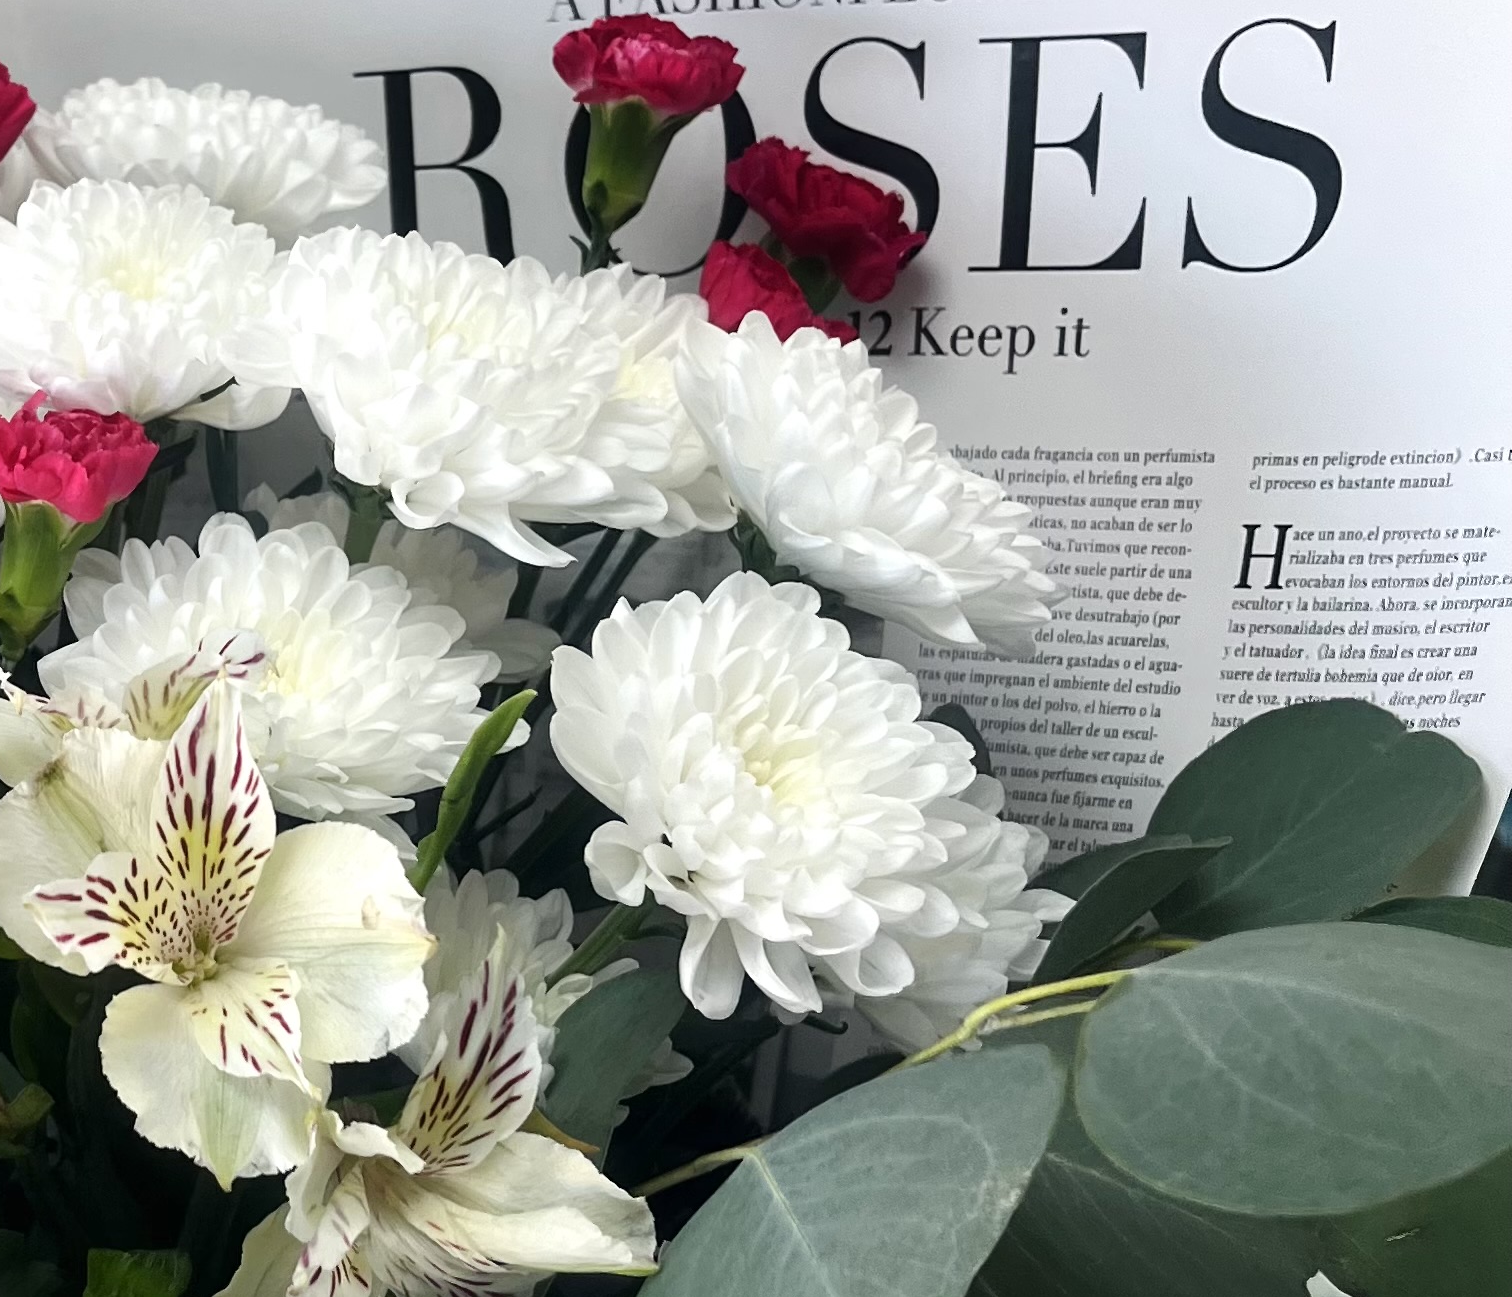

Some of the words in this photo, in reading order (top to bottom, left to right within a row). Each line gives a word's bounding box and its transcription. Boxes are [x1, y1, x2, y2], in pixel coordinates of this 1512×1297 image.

[353, 17, 1343, 273] ROSES
[908, 307, 1036, 374] Keep
[1053, 307, 1090, 357] it
[1001, 446, 1030, 460] cada
[1033, 446, 1093, 463] fragancia
[1097, 451, 1119, 462] con
[1124, 451, 1140, 462] un
[1143, 449, 1215, 466] perfumista
[1252, 452, 1299, 469] primas
[1302, 454, 1318, 466] en
[1073, 470, 1085, 484] el
[1088, 470, 1138, 488] briefing
[1141, 475, 1162, 486] era
[1165, 472, 1193, 489] algo
[1249, 475, 1261, 490] el
[1264, 477, 1316, 493] proceso
[1319, 477, 1333, 490] es
[1338, 474, 1395, 490] bastante
[1017, 493, 1086, 509] propuestas
[1089, 497, 1137, 511] aunque
[1140, 497, 1169, 509] eran
[1173, 498, 1202, 514] muy
[1070, 518, 1087, 530] no
[1090, 516, 1135, 532] acaban
[1138, 517, 1154, 532] de
[1157, 521, 1177, 533] ser
[1180, 517, 1193, 533] lo
[1318, 529, 1335, 541] un
[1382, 528, 1440, 545] proyecto
[1444, 528, 1459, 539] se
[1462, 526, 1501, 539] mate-
[1124, 544, 1148, 558] que
[1151, 544, 1192, 556] recon-
[1289, 550, 1345, 566] rializaba
[1349, 553, 1364, 565] en
[1368, 552, 1393, 565] tres
[1396, 549, 1459, 568] perfumes
[1462, 551, 1487, 565] que
[1074, 561, 1107, 576] suele
[1110, 562, 1146, 581] partir
[1149, 562, 1165, 578] de
[1168, 567, 1192, 579] una
[1285, 573, 1345, 589] evocaban
[1349, 573, 1368, 588] los
[1371, 574, 1429, 589] entornos
[1433, 571, 1453, 587] del
[1106, 589, 1130, 602] que
[1133, 587, 1164, 602] debe
[1166, 587, 1187, 602] de-
[1231, 596, 1283, 612] escultor
[1296, 597, 1309, 612] la
[1423, 601, 1438, 612] se
[1153, 611, 1181, 627] (por
[1227, 619, 1246, 634] las
[1248, 619, 1346, 638] personalidades
[1348, 619, 1368, 635] del
[1424, 619, 1436, 634] el
[1439, 618, 1491, 634] escritor
[1035, 628, 1054, 643] del
[918, 643, 937, 658] las
[1066, 654, 1120, 669] gastadas
[1123, 658, 1131, 669] o
[1134, 655, 1146, 670] el
[1148, 659, 1183, 674] agua-
[1223, 646, 1231, 660] y
[1234, 643, 1246, 659] el
[1339, 643, 1366, 659] idea
[1369, 644, 1399, 659] final
[1400, 647, 1414, 659] es
[1417, 646, 1451, 659] crear
[1454, 645, 1478, 657] una
[944, 670, 966, 684] que
[969, 668, 1035, 689] impregnan
[1038, 672, 1050, 688] el
[1053, 674, 1110, 691] ambiente
[1113, 675, 1132, 693] del
[1135, 677, 1181, 696] estudio
[1256, 666, 1272, 681] de
[1275, 667, 1321, 683] tertulia
[1324, 667, 1378, 683] bohemia
[1381, 670, 1405, 686] que
[1407, 666, 1423, 682] de
[1457, 669, 1473, 680] en
[932, 691, 947, 702] un
[991, 694, 999, 705] o
[1002, 692, 1020, 707] los
[1022, 693, 1042, 710] del
[1084, 699, 1096, 714] el
[1099, 699, 1136, 716] hierro
[1139, 705, 1147, 717] o
[1150, 702, 1161, 718] la
[1216, 693, 1235, 704] ver
[1238, 689, 1253, 704] de
[1449, 690, 1486, 708] llegar
[980, 715, 1026, 733] propios
[1029, 716, 1048, 734] del
[1051, 719, 1083, 737] taller
[1085, 720, 1100, 737] de
[1103, 725, 1119, 738] un
[1122, 722, 1158, 741] escul-
[1418, 713, 1461, 728] noches
[1034, 743, 1057, 760] que
[1059, 741, 1089, 759] debe
[1092, 749, 1109, 761] ser
[1112, 747, 1146, 767] capaz
[1149, 747, 1164, 765] de
[1011, 764, 1039, 778] unos
[1042, 764, 1098, 784] perfumes
[1051, 789, 1068, 804] fue
[1072, 791, 1116, 809] fijarme
[1119, 798, 1133, 810] en
[1041, 810, 1056, 827] de
[1059, 812, 1070, 828] la
[1072, 817, 1108, 831] marca
